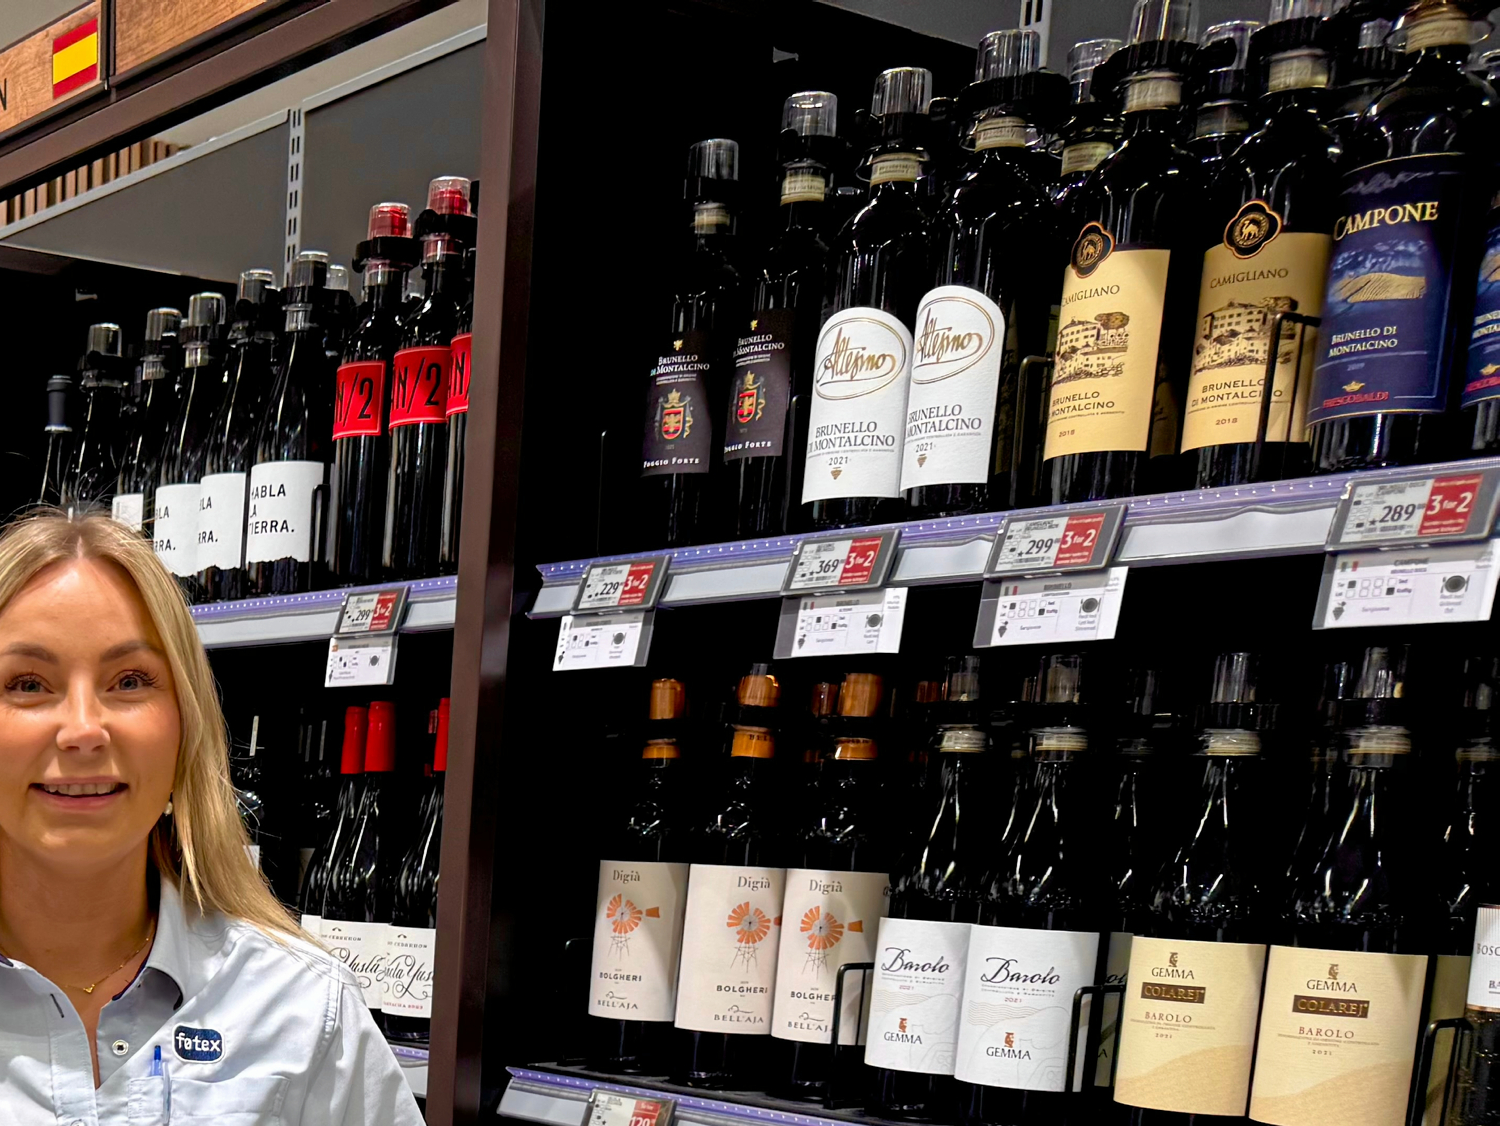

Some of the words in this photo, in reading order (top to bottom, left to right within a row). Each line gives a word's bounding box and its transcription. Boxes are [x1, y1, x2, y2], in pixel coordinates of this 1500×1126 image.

[1334, 201, 1439, 242] CAMPONE
[1210, 267, 1288, 289] CAMIGLIANO
[1332, 327, 1381, 345] BRUNELLO
[1383, 325, 1397, 336] DI
[1328, 338, 1398, 358] MONTALCINO
[658, 354, 698, 366] BRUNELLO
[656, 363, 710, 375] MONTALCINO
[1200, 389, 1283, 404] MONTALCIO
[815, 421, 878, 438] BRUNELLO
[1215, 417, 1238, 426] 2018
[813, 435, 895, 452] MONTALCINO
[828, 456, 849, 466] 2021
[1379, 503, 1416, 523] 289
[1426, 495, 1443, 516] 3
[1442, 500, 1457, 509] for
[1456, 491, 1473, 513] 2
[1025, 539, 1053, 555] 299
[1061, 531, 1074, 548] 3
[1082, 529, 1096, 547] 2
[816, 559, 839, 574] 369
[845, 553, 856, 568] 3
[863, 551, 874, 567] 2
[600, 582, 619, 596] 229
[624, 576, 634, 590] 3
[638, 574, 648, 589] 2
[374, 604, 381, 617] 3
[384, 603, 392, 617] 2
[612, 869, 641, 885] Digià
[737, 876, 771, 892] Digià
[808, 879, 843, 896] Digià
[881, 947, 950, 974] Barolo
[980, 957, 1060, 986] Barolo
[1151, 966, 1195, 980] GEMMA
[1306, 979, 1358, 993] GEMMA
[790, 990, 837, 1002] BOLGHER
[1145, 1012, 1192, 1023] BAROLO
[788, 1021, 834, 1032] BELL'AJ
[1299, 1027, 1355, 1039] BAROLO
[175, 1032, 221, 1052] føtex
[884, 1032, 923, 1045] GEMMA
[986, 1046, 1031, 1061] GEMMA
